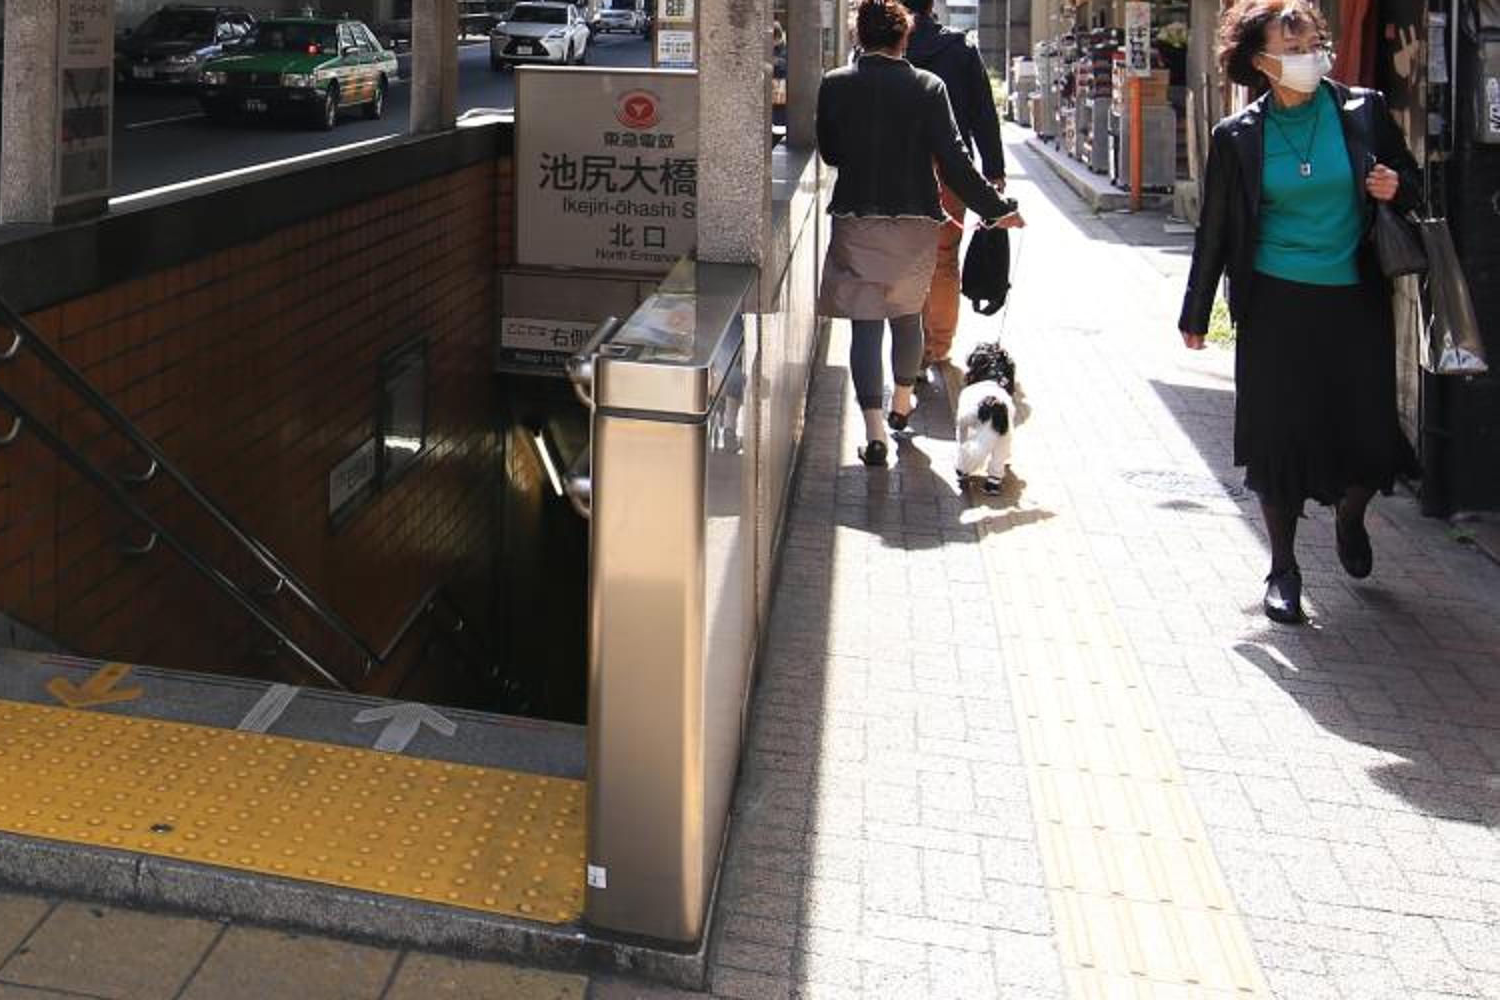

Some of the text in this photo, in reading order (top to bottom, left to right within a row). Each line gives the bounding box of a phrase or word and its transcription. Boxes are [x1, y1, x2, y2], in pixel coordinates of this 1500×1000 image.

[538, 152, 697, 197] 池尻大橋
[609, 223, 666, 249] 北口
